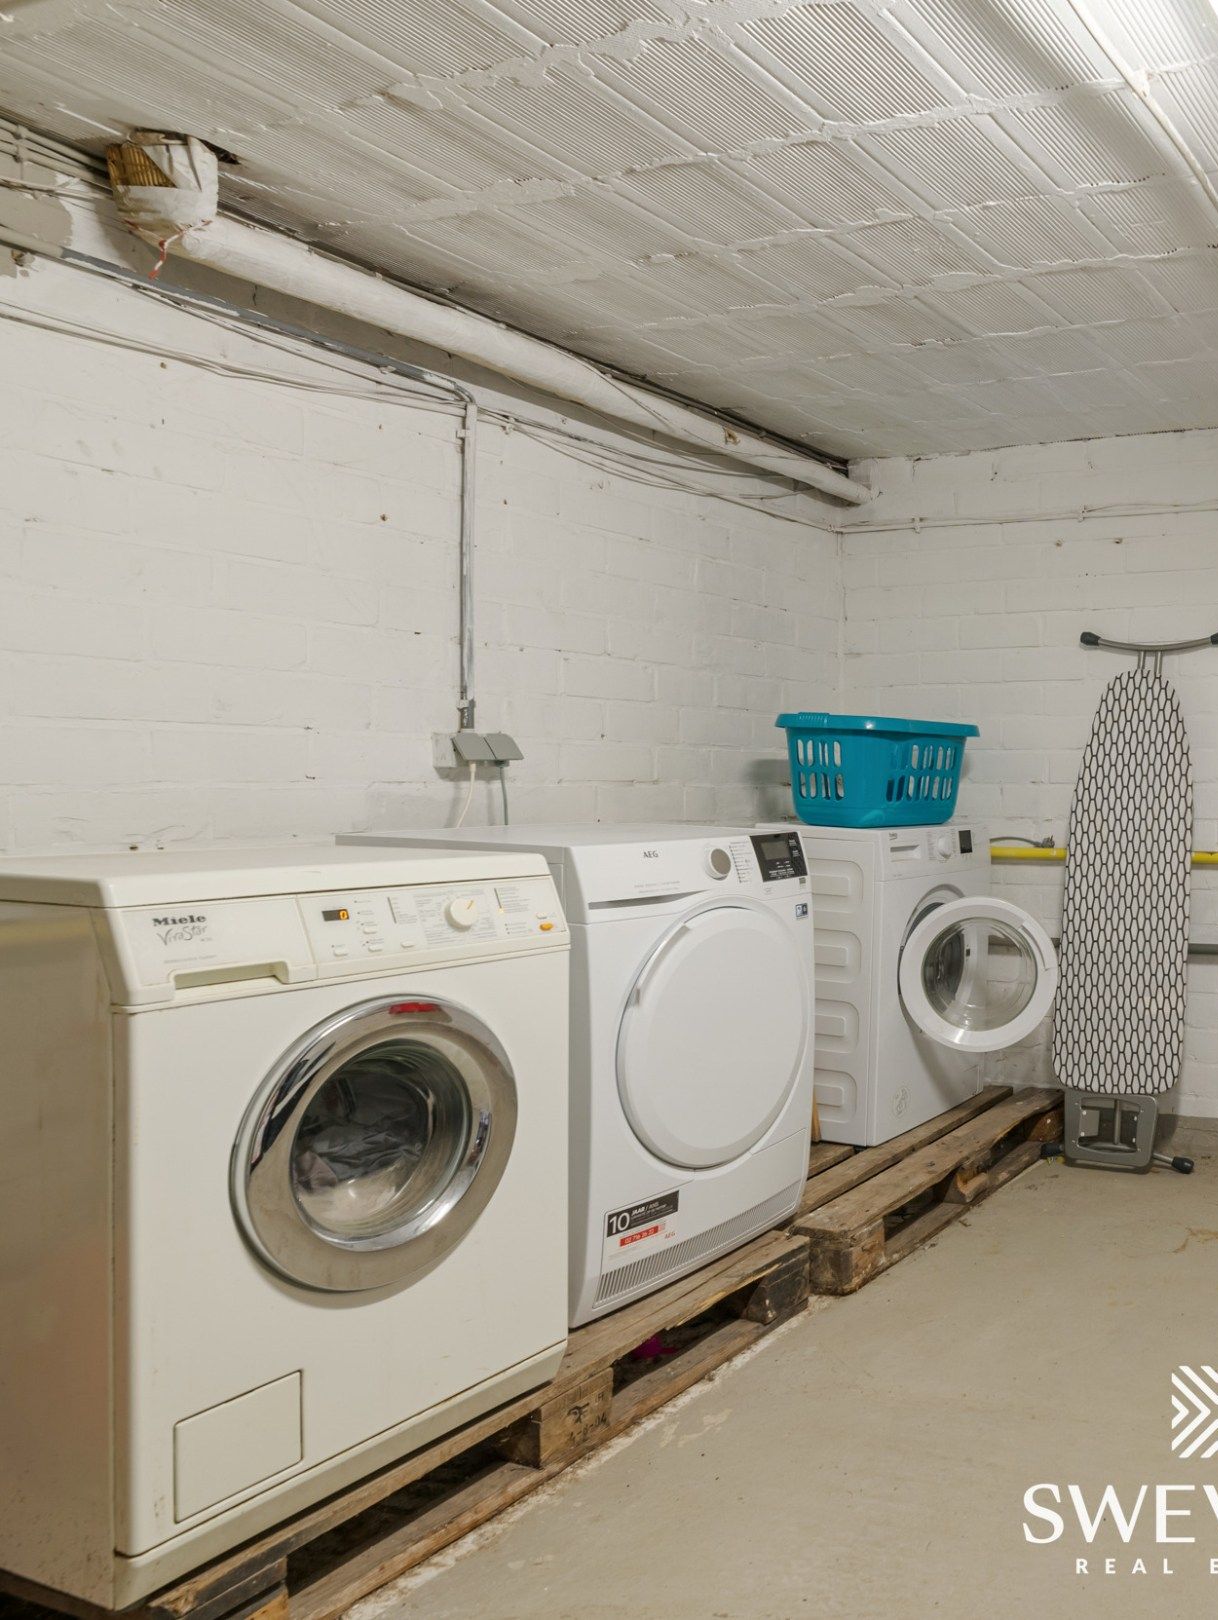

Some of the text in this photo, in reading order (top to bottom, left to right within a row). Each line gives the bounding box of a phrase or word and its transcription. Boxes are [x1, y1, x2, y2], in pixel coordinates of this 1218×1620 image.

[643, 850, 659, 858] AEG
[152, 914, 207, 927] Miele
[609, 1212, 630, 1234] 10
